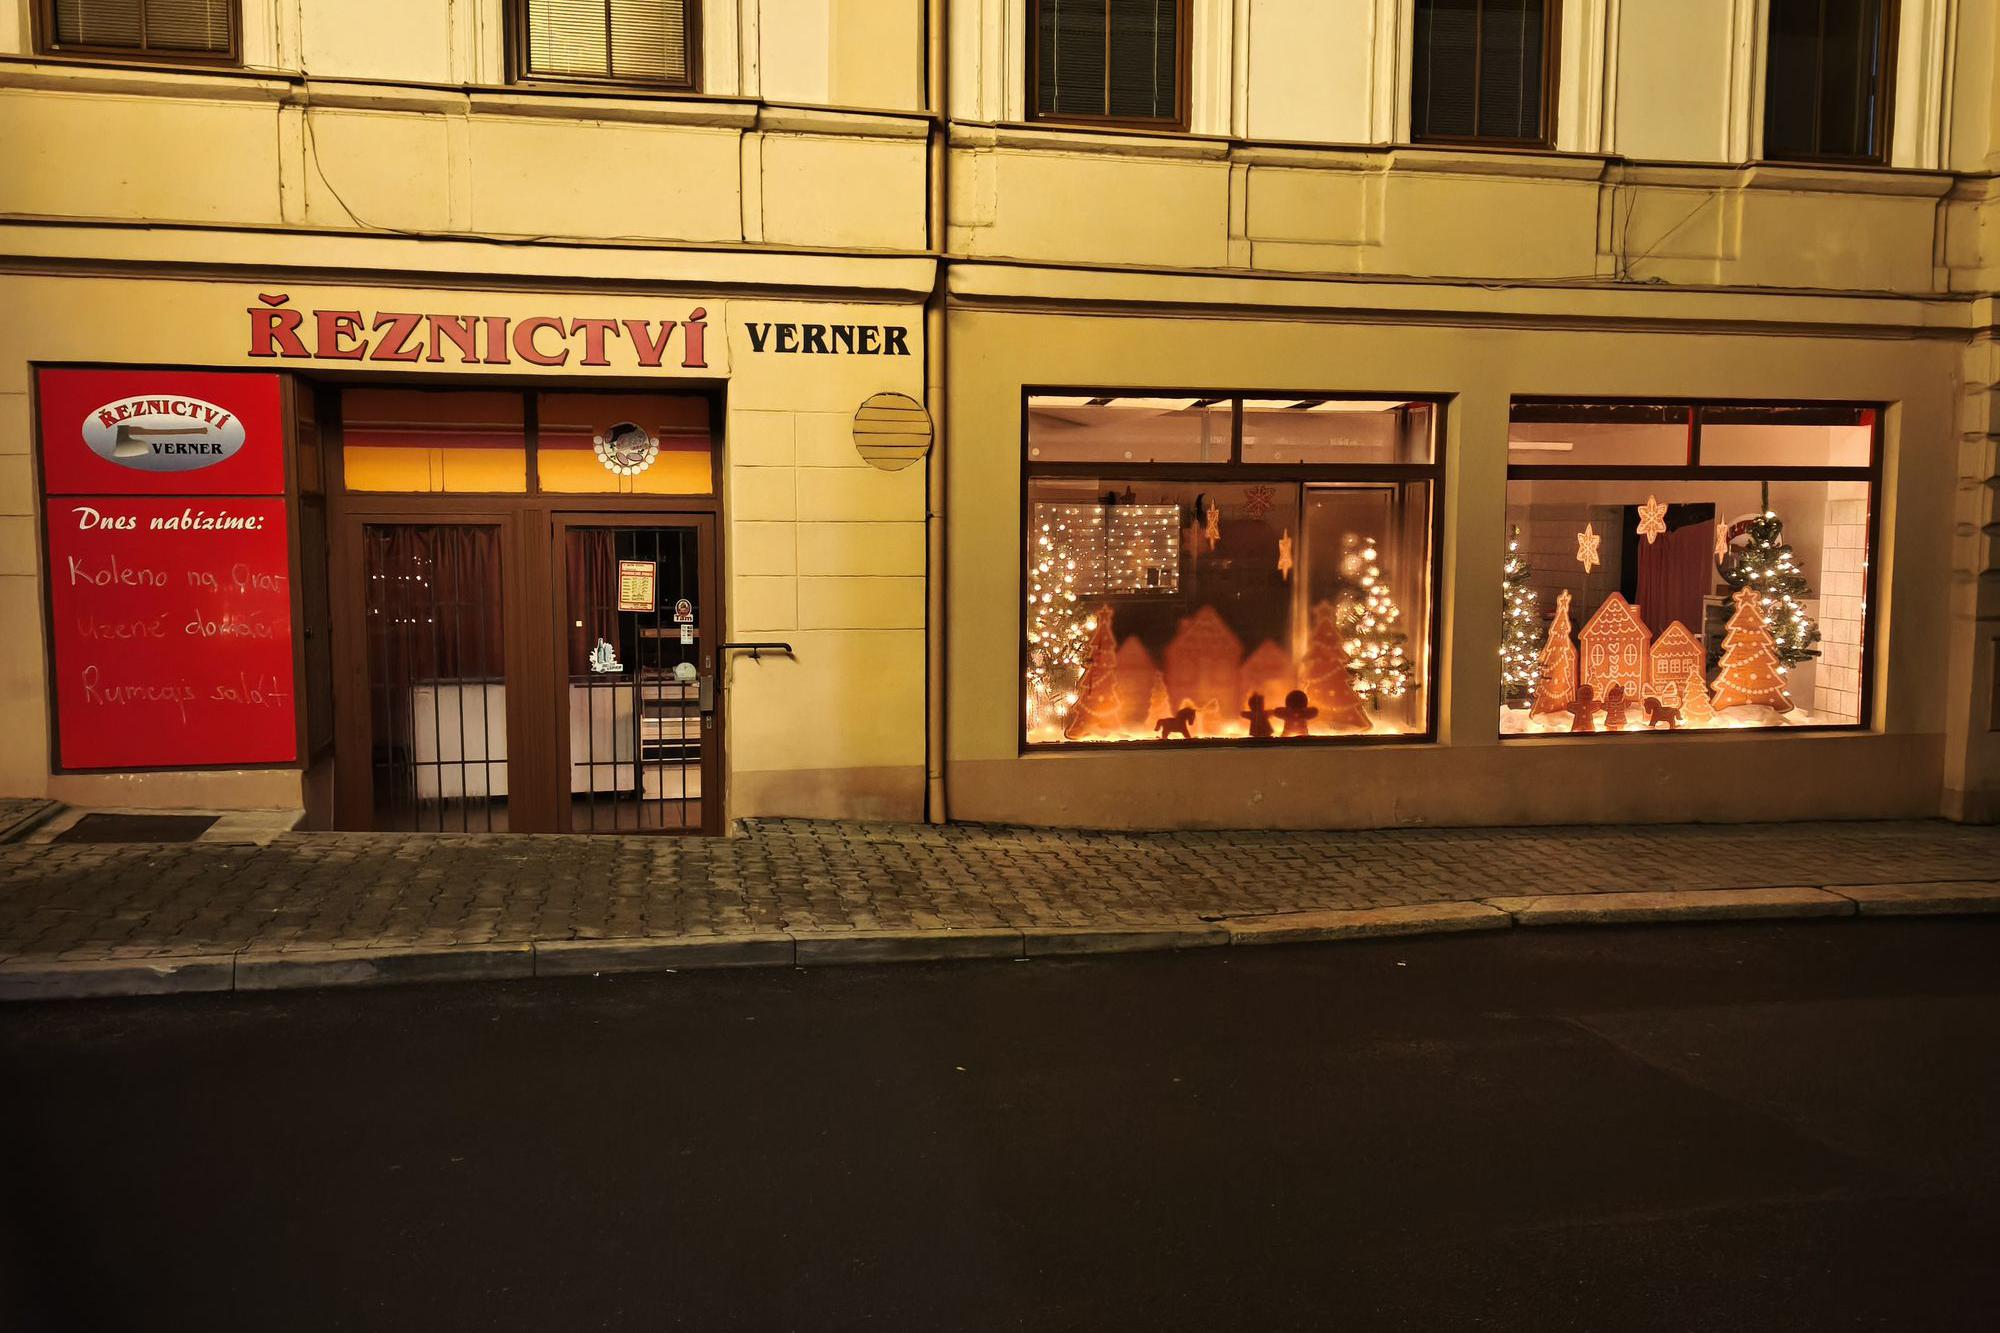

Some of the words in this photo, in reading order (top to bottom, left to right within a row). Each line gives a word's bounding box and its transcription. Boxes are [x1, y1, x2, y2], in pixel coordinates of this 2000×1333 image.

[247, 293, 709, 369] ŘEZNICTVÍ
[744, 322, 911, 356] VERNER
[98, 400, 231, 430] ŘEZNICTVÍ
[152, 443, 223, 454] VERNER
[72, 506, 137, 530] Dnes
[150, 508, 265, 530] nabízíme:
[68, 554, 168, 587] Koleno
